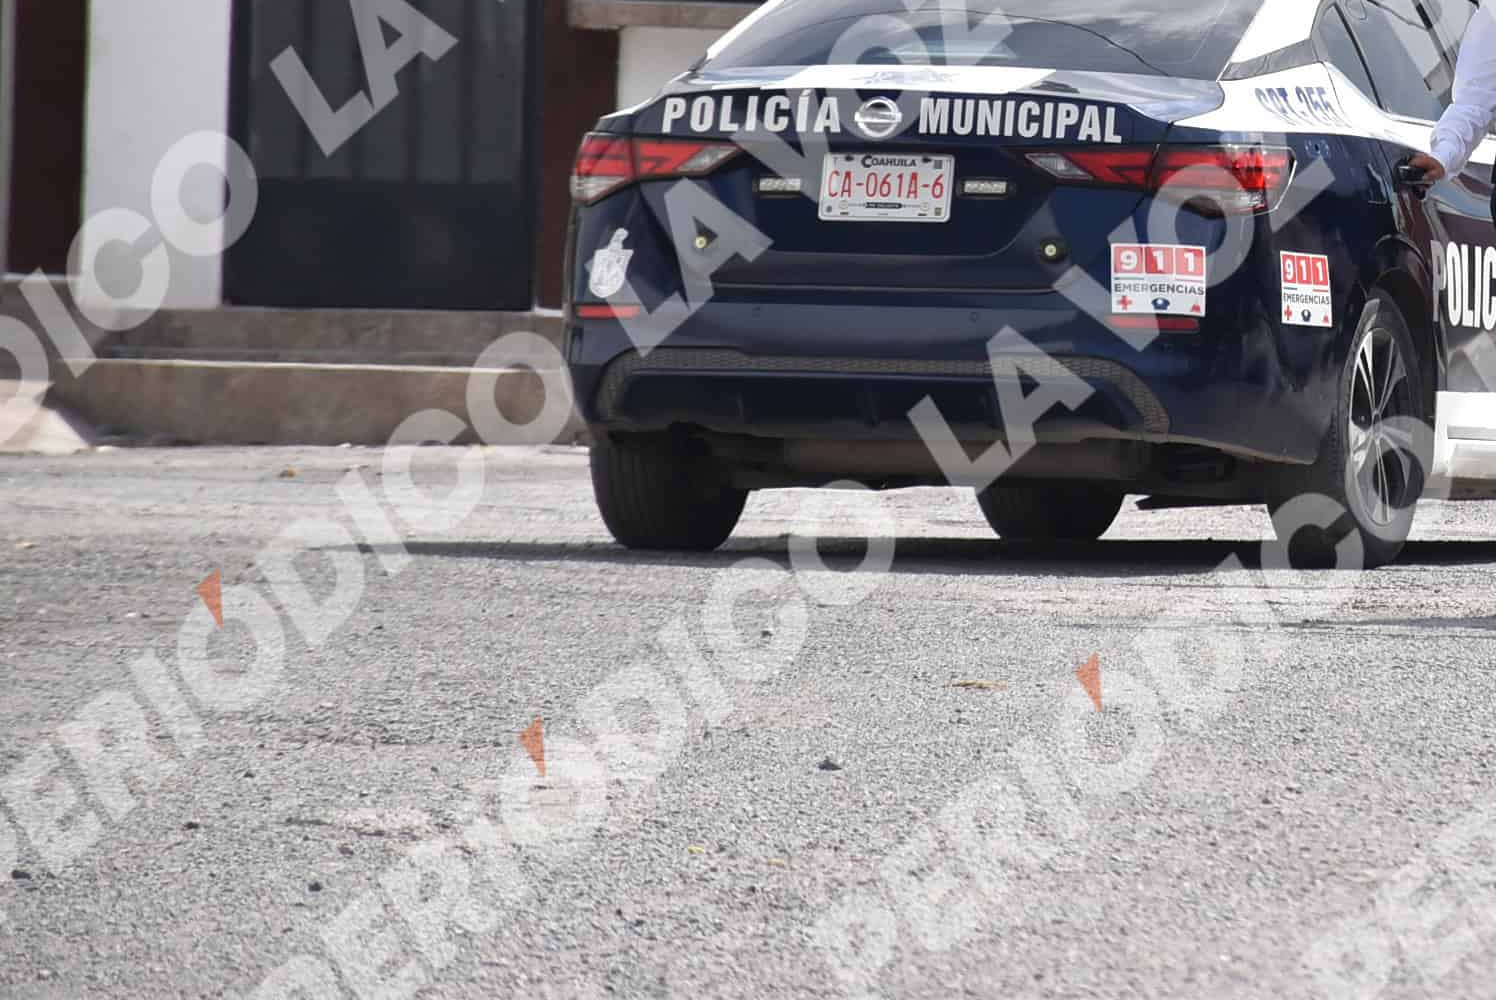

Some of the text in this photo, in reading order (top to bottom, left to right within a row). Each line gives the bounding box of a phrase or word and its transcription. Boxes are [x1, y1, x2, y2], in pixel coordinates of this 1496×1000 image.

[661, 90, 1122, 144] POLICÍA MUNICIPAL
[861, 155, 917, 168] COAHUILA
[828, 171, 945, 200] CA-061A-6
[1118, 249, 1198, 273] 911
[1283, 258, 1325, 283] 911
[1114, 282, 1205, 296] EMERGENCIAS
[1282, 292, 1331, 305] EMERGENCIAS
